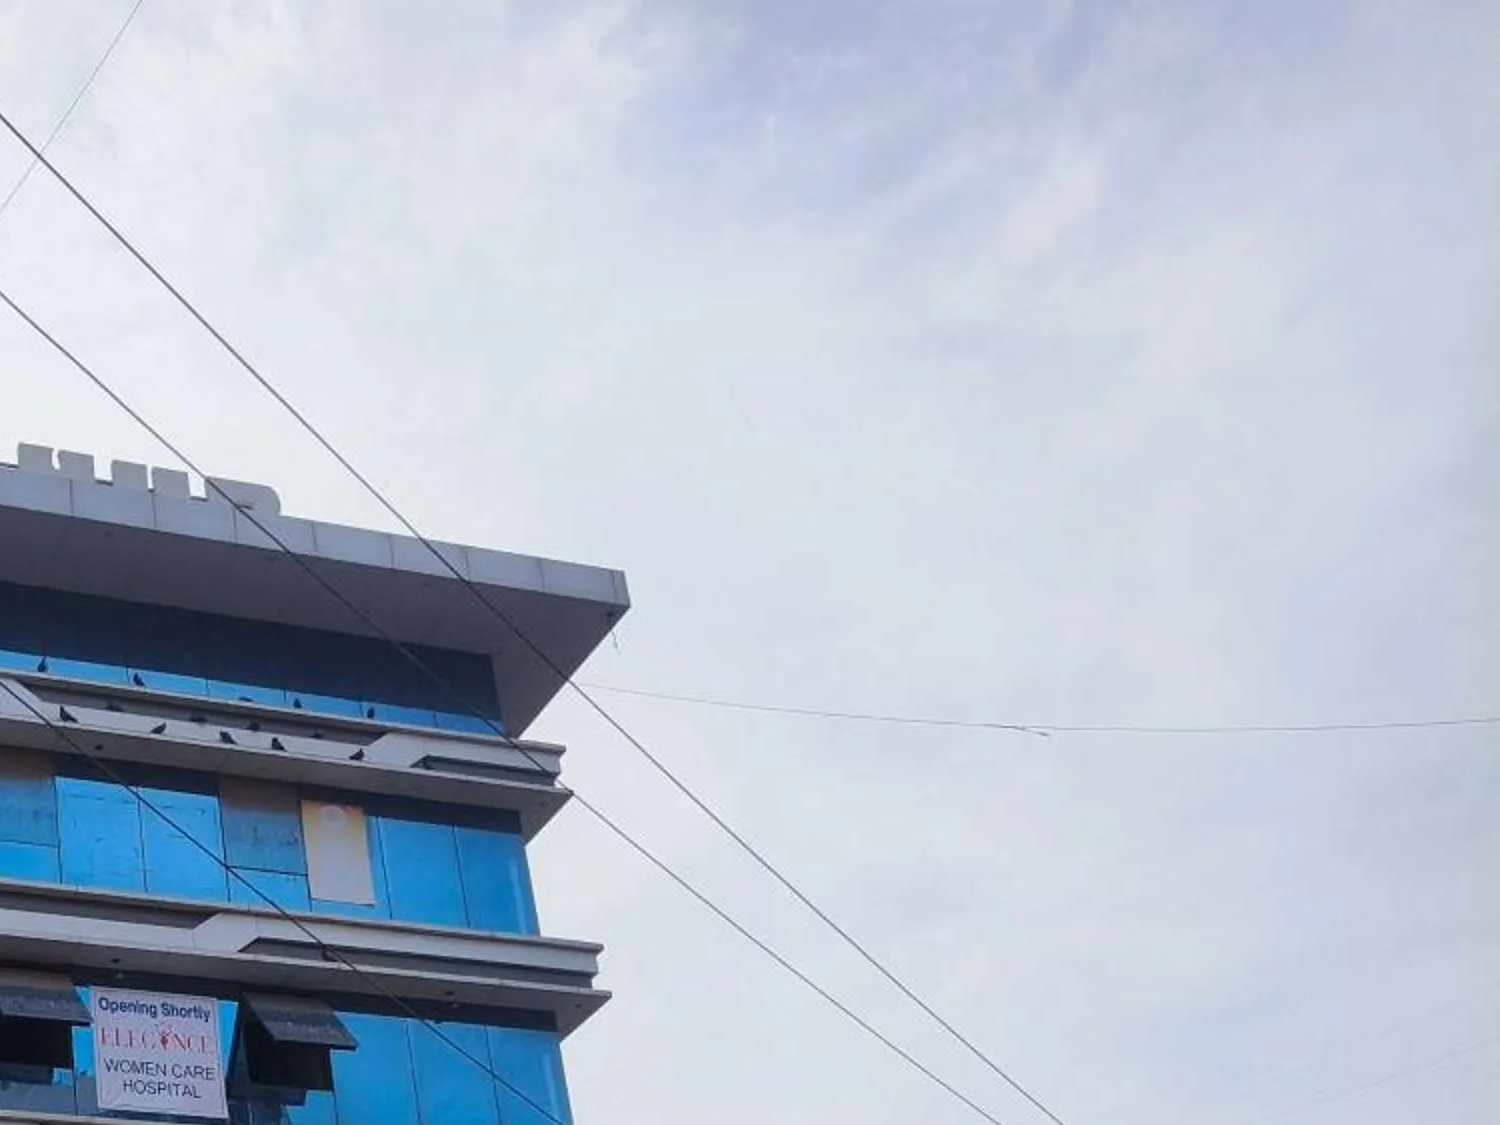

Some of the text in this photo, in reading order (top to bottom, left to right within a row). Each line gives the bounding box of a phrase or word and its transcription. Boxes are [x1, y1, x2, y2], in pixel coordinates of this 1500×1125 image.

[99, 997, 211, 1022] Opening Shortly
[104, 1059, 216, 1080] WOMEN CARE
[123, 1079, 202, 1098] HOSPITAL
